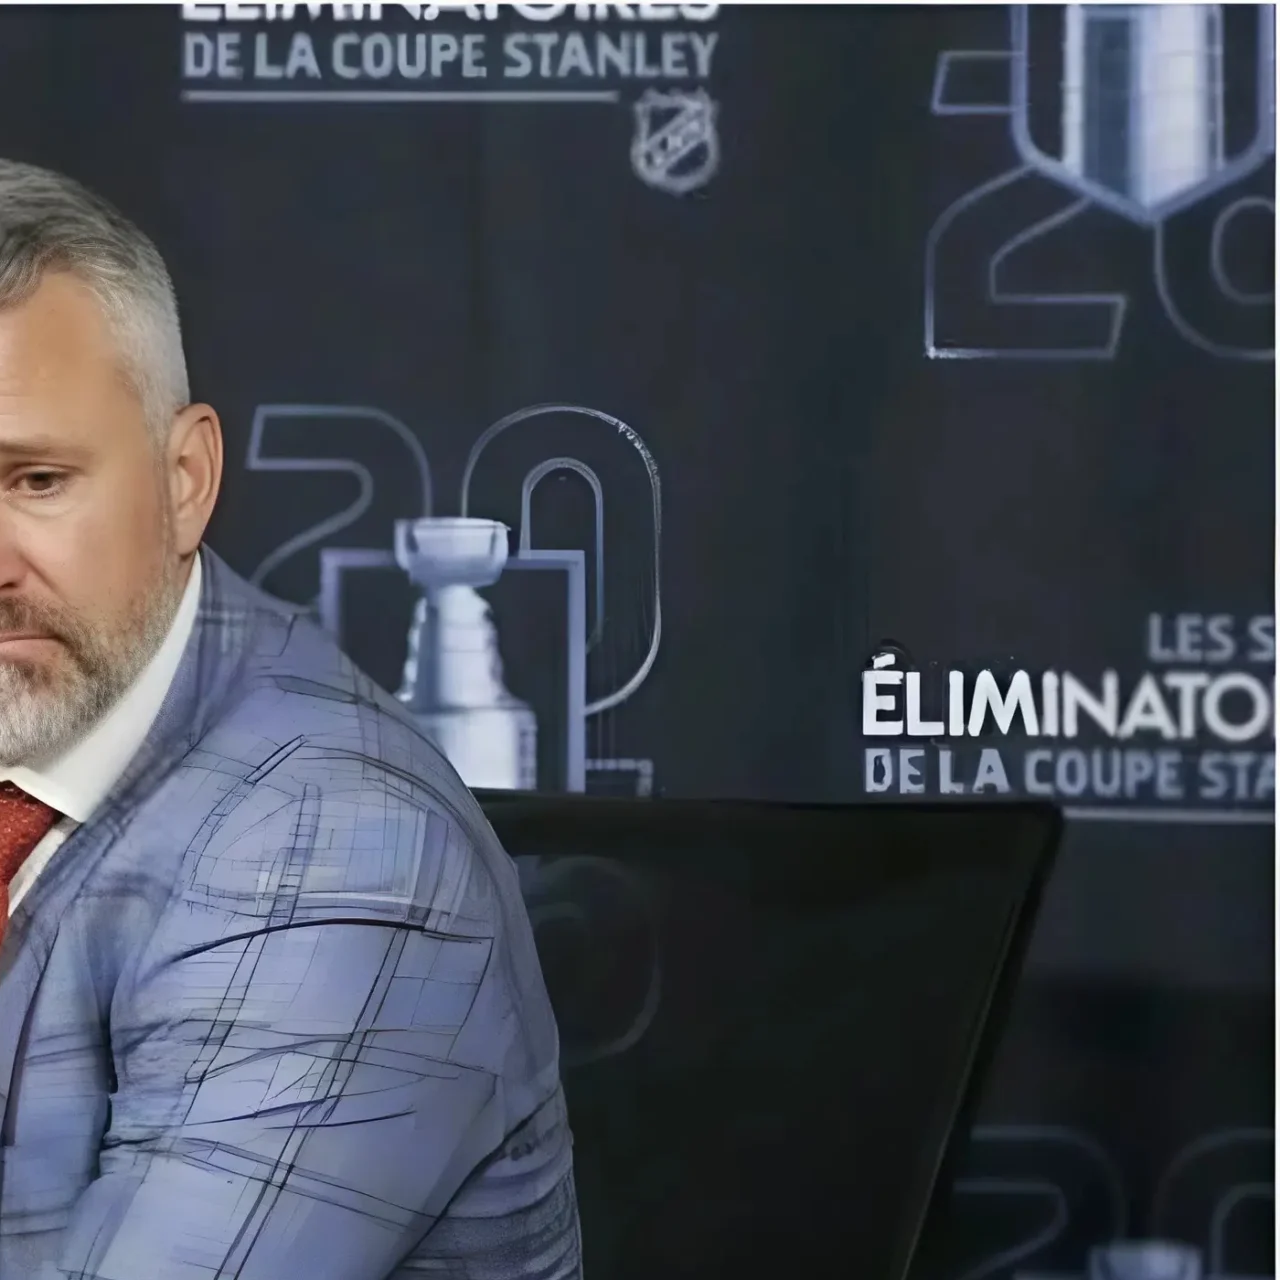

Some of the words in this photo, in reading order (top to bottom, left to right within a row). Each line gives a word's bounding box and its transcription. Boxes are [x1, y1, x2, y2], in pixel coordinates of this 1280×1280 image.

[183, 32, 243, 80] DE
[253, 32, 322, 80] LA
[331, 32, 488, 80] COUPE
[502, 32, 720, 80] STANLEY
[1147, 612, 1236, 664] LES
[860, 652, 1276, 742] ÉLIMINATO
[864, 747, 926, 794] DE
[938, 747, 1014, 795] LA
[1023, 749, 1185, 797] COUPE
